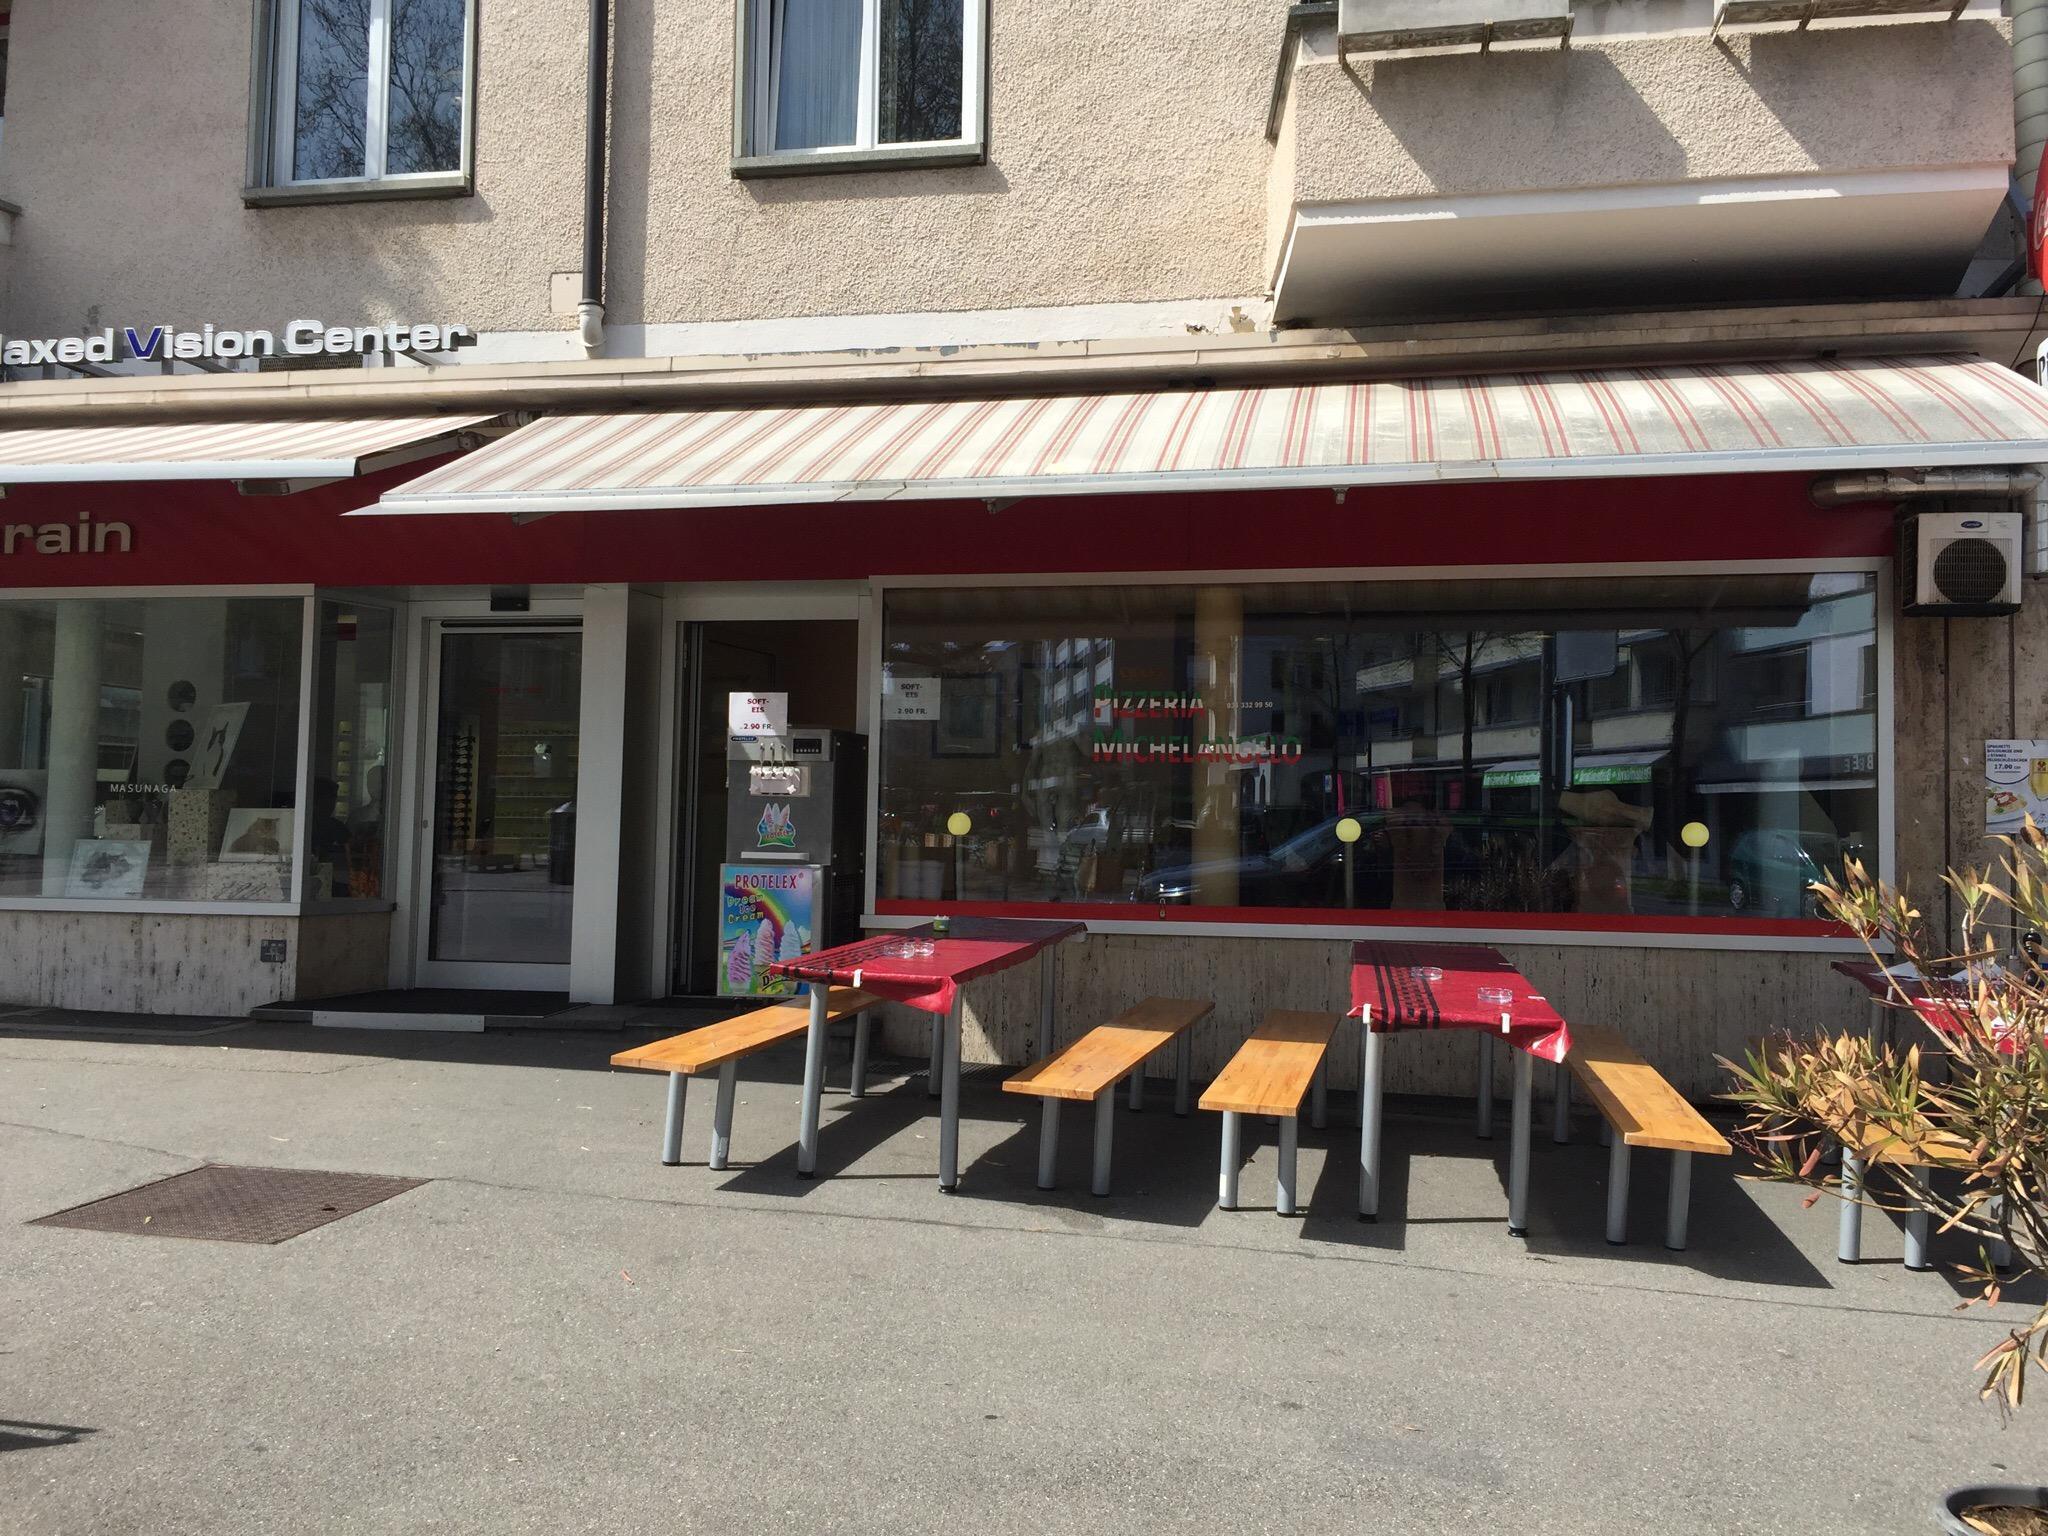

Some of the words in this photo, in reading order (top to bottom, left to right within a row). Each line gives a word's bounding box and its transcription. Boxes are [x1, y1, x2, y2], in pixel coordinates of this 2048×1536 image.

[0, 328, 114, 365] axed
[124, 323, 273, 360] Vision
[286, 319, 469, 355] Center
[4, 511, 131, 554] rain
[1093, 684, 1206, 718] PIZZERIA
[1091, 727, 1303, 764] MICHELANGELO
[110, 783, 177, 793] MASUNAGA
[735, 873, 798, 890] PROTELEX
